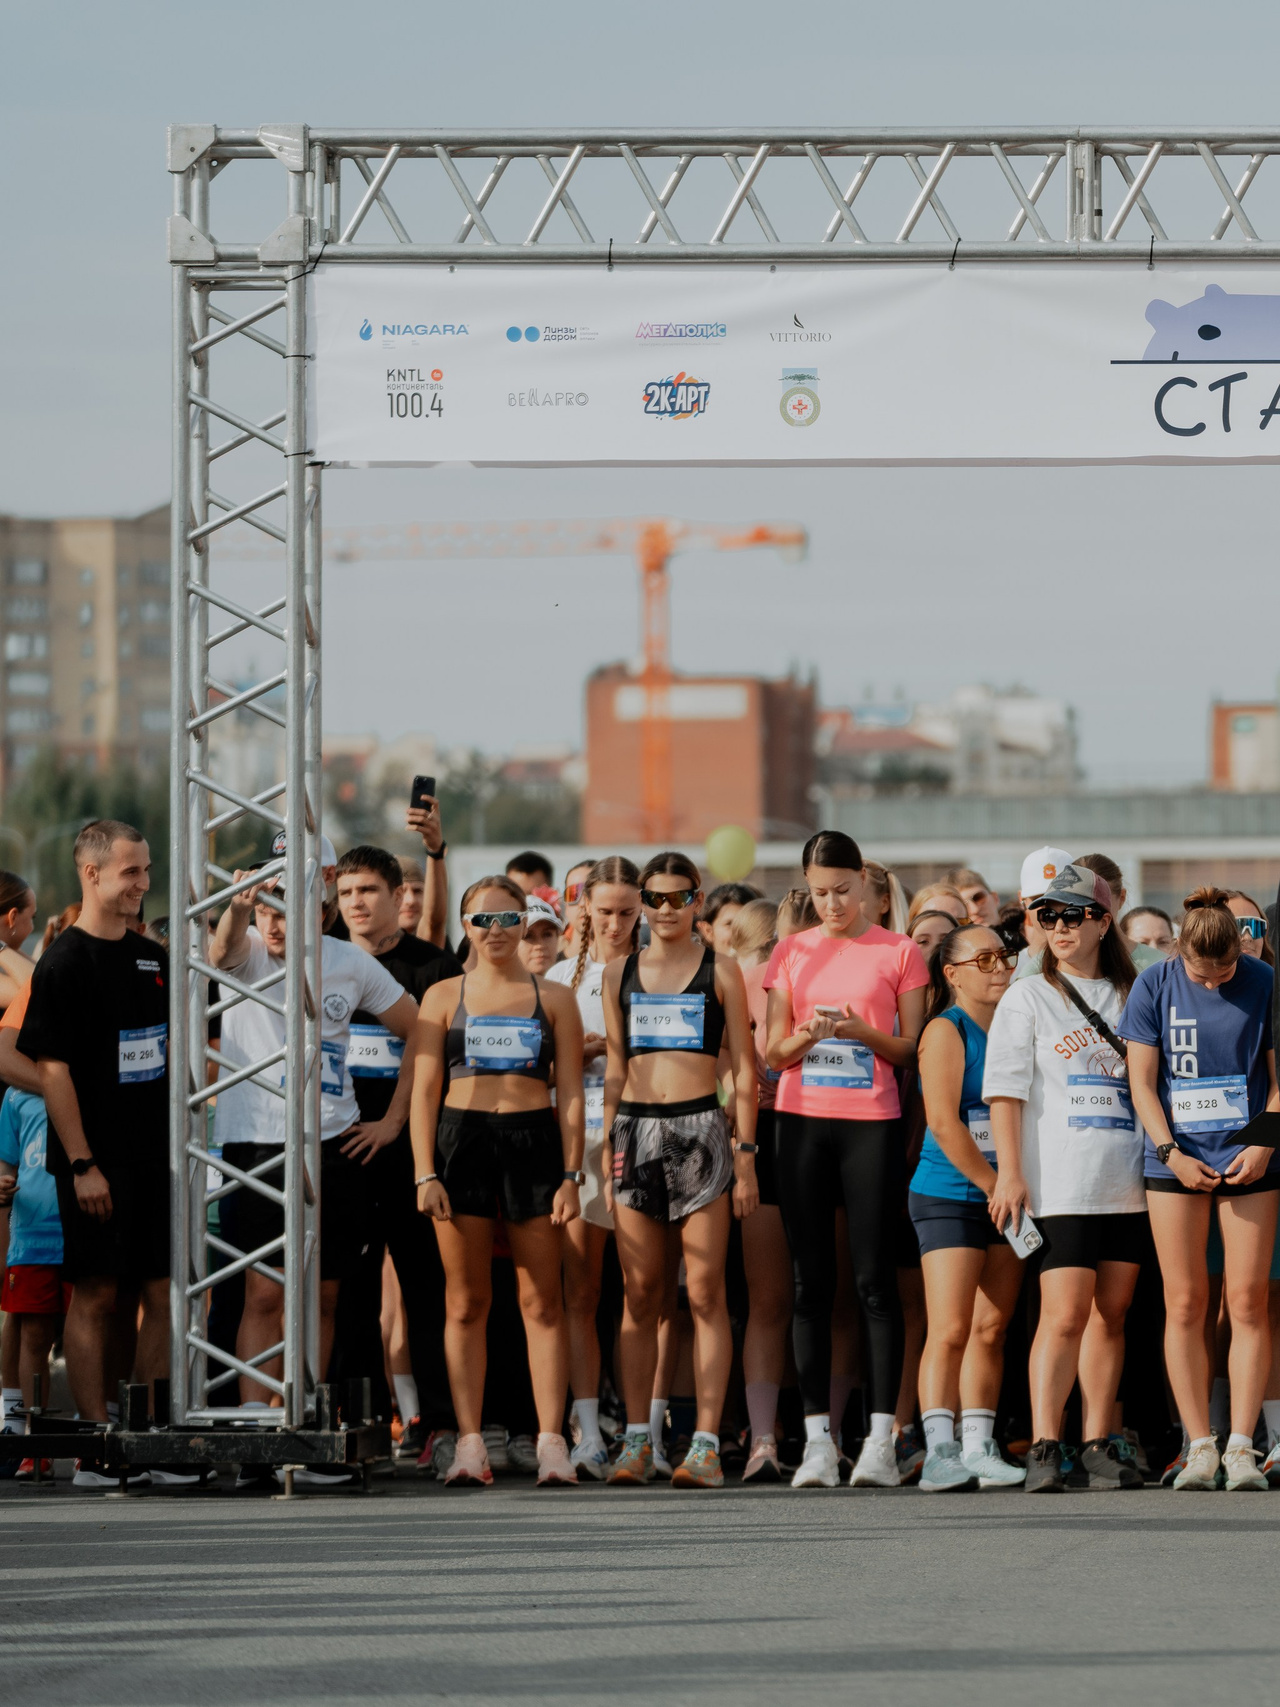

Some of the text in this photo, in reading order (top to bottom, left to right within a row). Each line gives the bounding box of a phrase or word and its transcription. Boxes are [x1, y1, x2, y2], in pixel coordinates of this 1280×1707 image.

[382, 324, 469, 336] NIAGARA
[543, 326, 577, 334] Линзы
[543, 334, 577, 342] даром
[769, 333, 832, 343] VITTORIO
[386, 369, 425, 382] KNTL
[387, 392, 444, 418] 100.4
[653, 1015, 671, 1025] 179
[486, 1036, 513, 1047] 040
[1170, 1006, 1198, 1078] БЕГ
[358, 1046, 379, 1056] 299
[824, 1055, 844, 1065] 145
[1090, 1095, 1113, 1106] 088
[1197, 1099, 1218, 1109] 328
